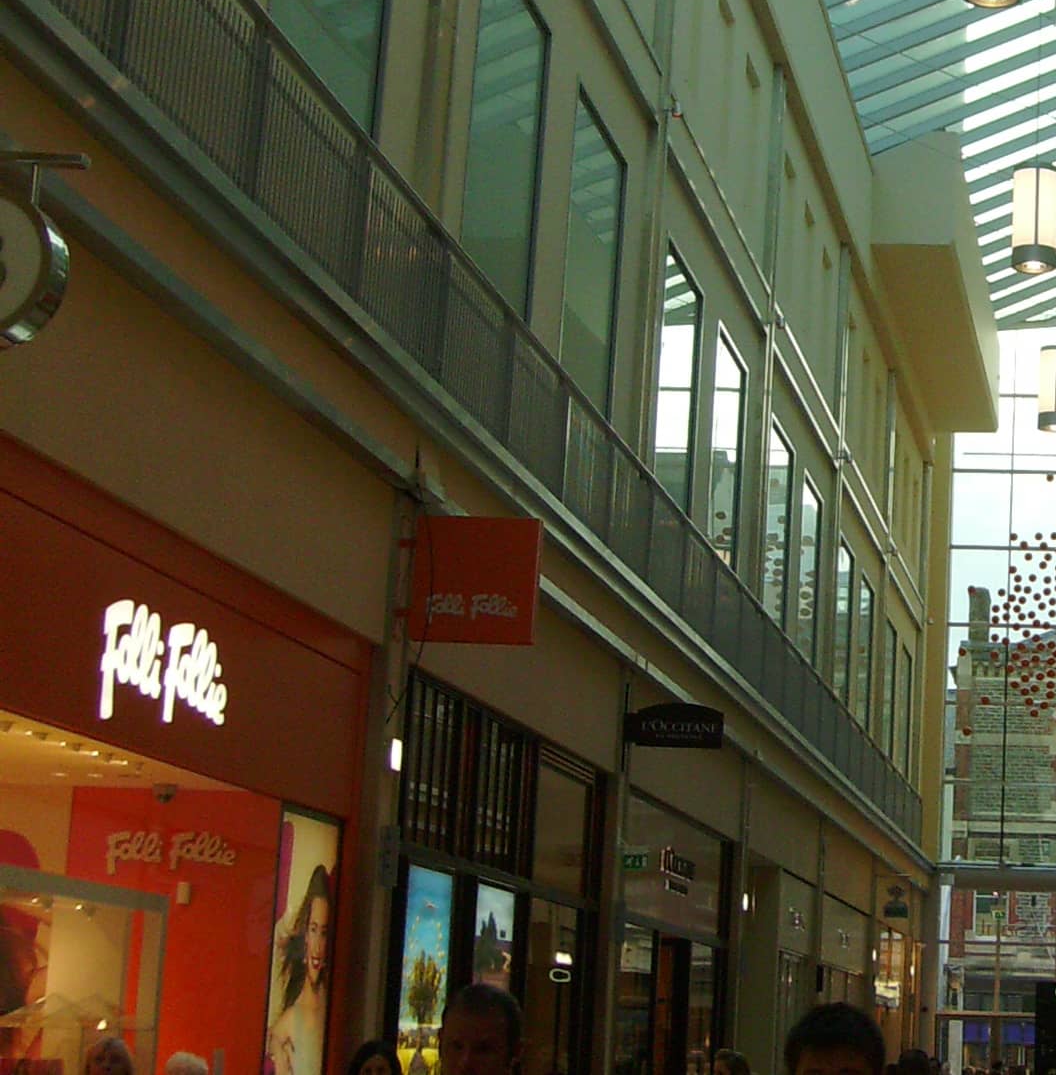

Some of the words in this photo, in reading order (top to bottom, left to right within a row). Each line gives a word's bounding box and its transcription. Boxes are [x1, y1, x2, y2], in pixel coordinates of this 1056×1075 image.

[426, 593, 465, 625] Folli
[470, 594, 519, 620] Follie
[100, 598, 165, 721] Folli
[162, 622, 228, 726] Follie
[105, 830, 164, 876] Folli
[168, 831, 236, 871] Follie
